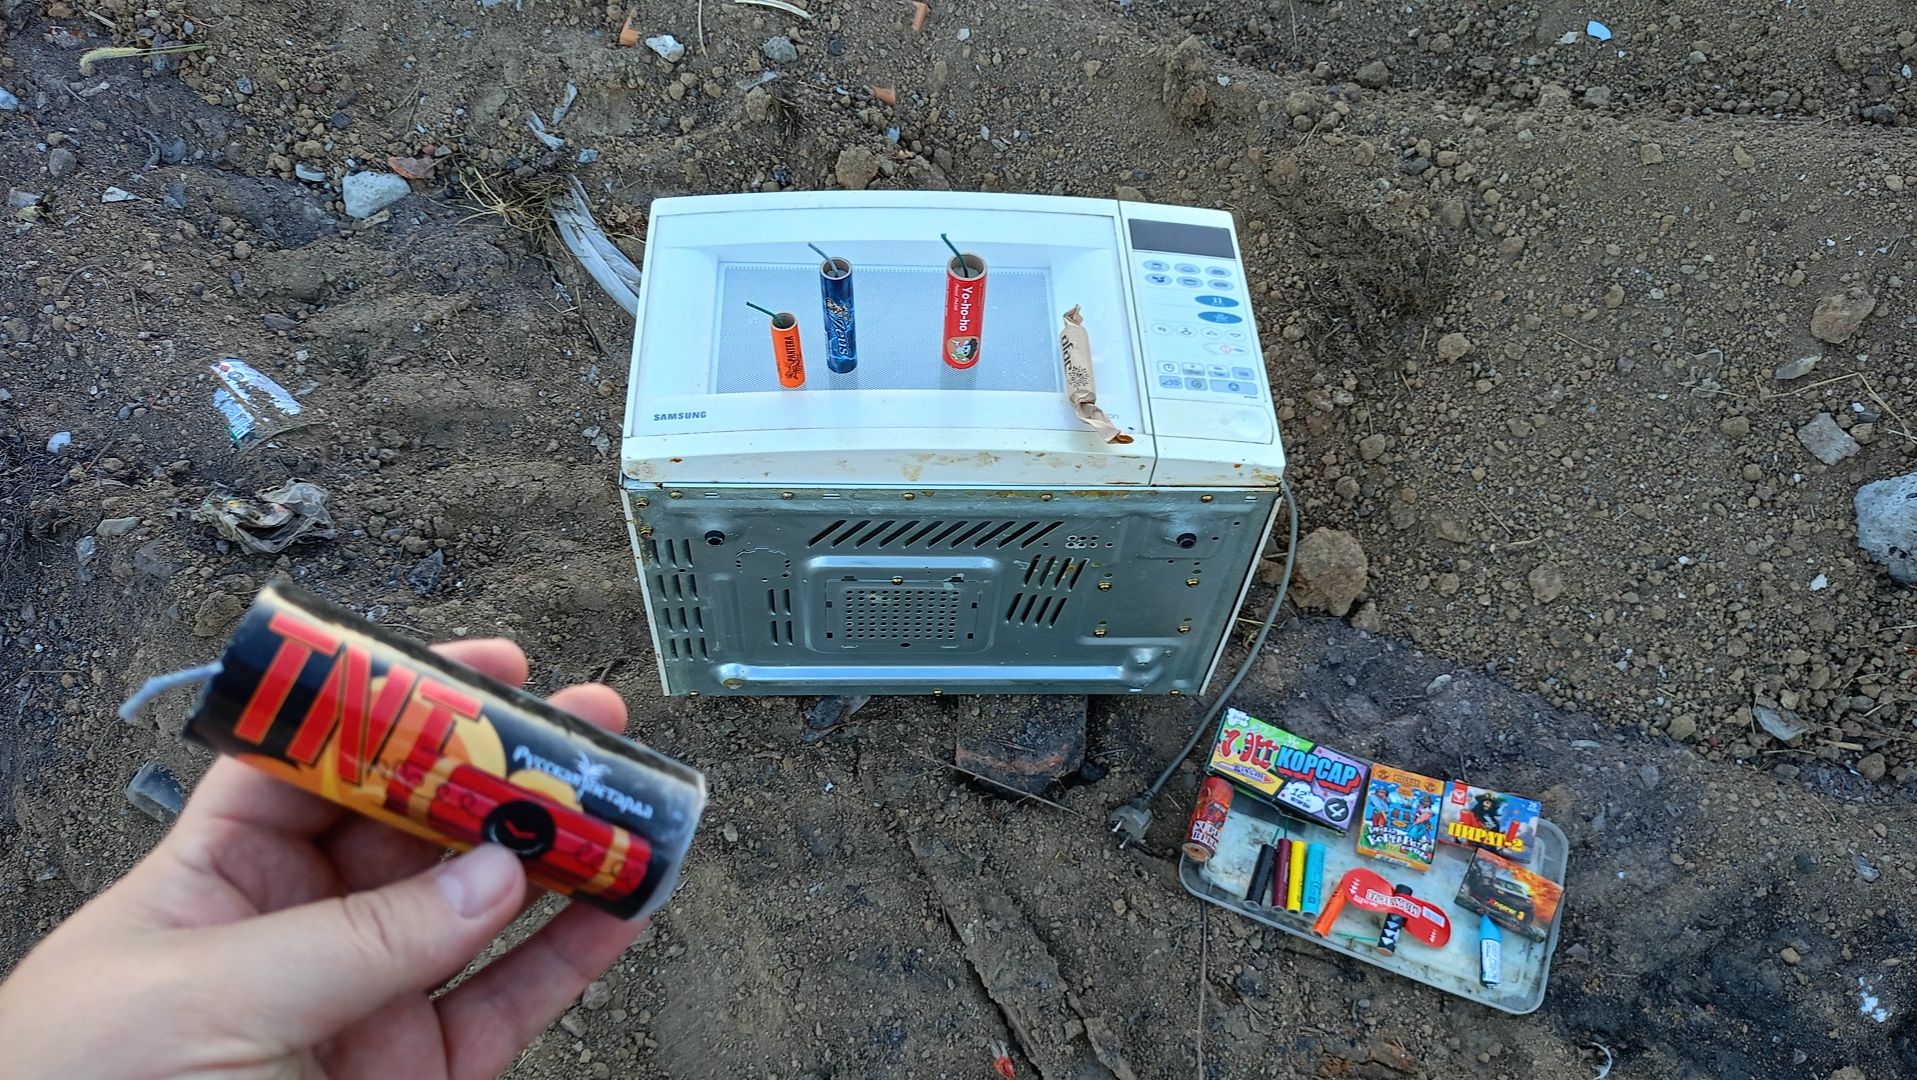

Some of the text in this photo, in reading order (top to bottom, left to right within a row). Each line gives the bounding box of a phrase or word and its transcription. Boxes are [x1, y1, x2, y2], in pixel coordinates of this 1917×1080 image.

[959, 286, 973, 332] Yo-ho-ho
[784, 335, 797, 363] PANTERA
[829, 315, 849, 356] Zeus
[653, 410, 707, 421] SAMSUNG
[234, 610, 485, 786] TNT
[512, 745, 583, 787] Русская
[1276, 745, 1360, 788] КОРСАР
[1328, 802, 1346, 818] 4
